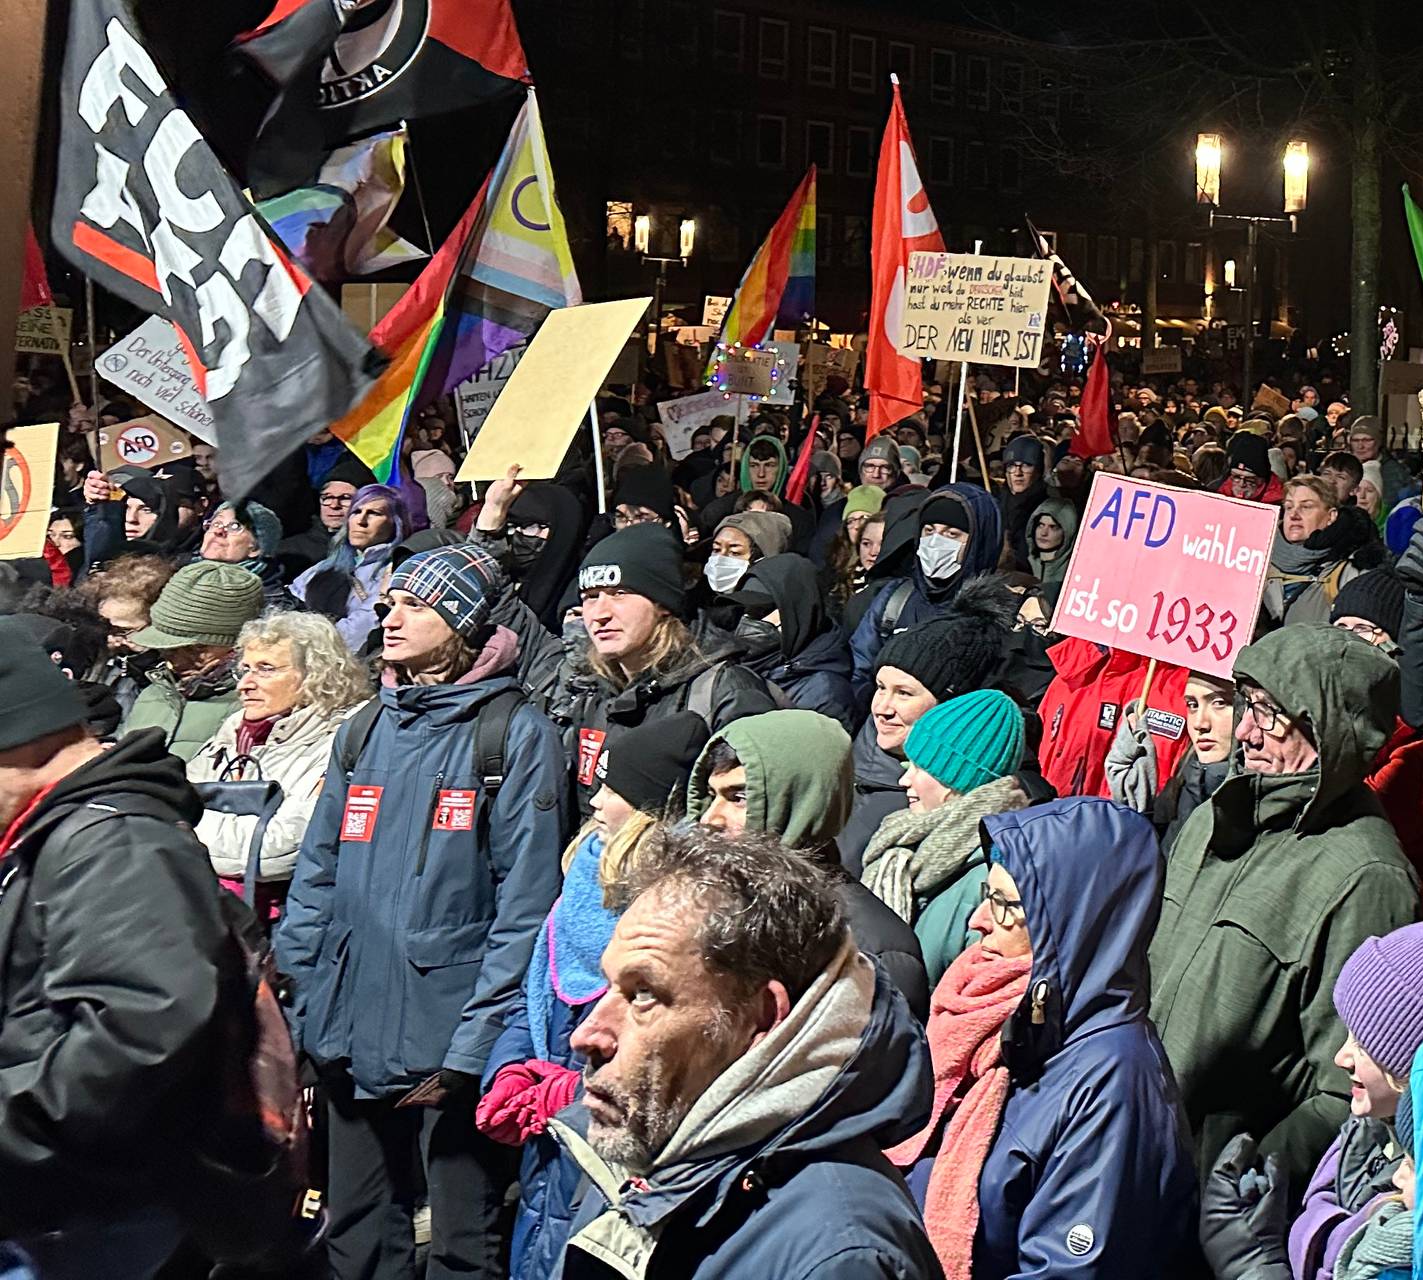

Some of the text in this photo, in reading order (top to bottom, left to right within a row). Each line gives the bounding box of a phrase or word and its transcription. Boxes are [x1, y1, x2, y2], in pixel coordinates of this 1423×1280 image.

[948, 266, 983, 281] wenn
[986, 260, 1002, 281] du
[909, 284, 929, 295] nur
[930, 300, 940, 311] du
[966, 296, 1005, 311] RECHTE
[904, 324, 939, 350] DER
[980, 329, 1011, 358] HIER
[1013, 330, 1041, 361] IST
[1090, 486, 1265, 577] AFD wählen
[1063, 574, 1239, 662] ist so 1933
